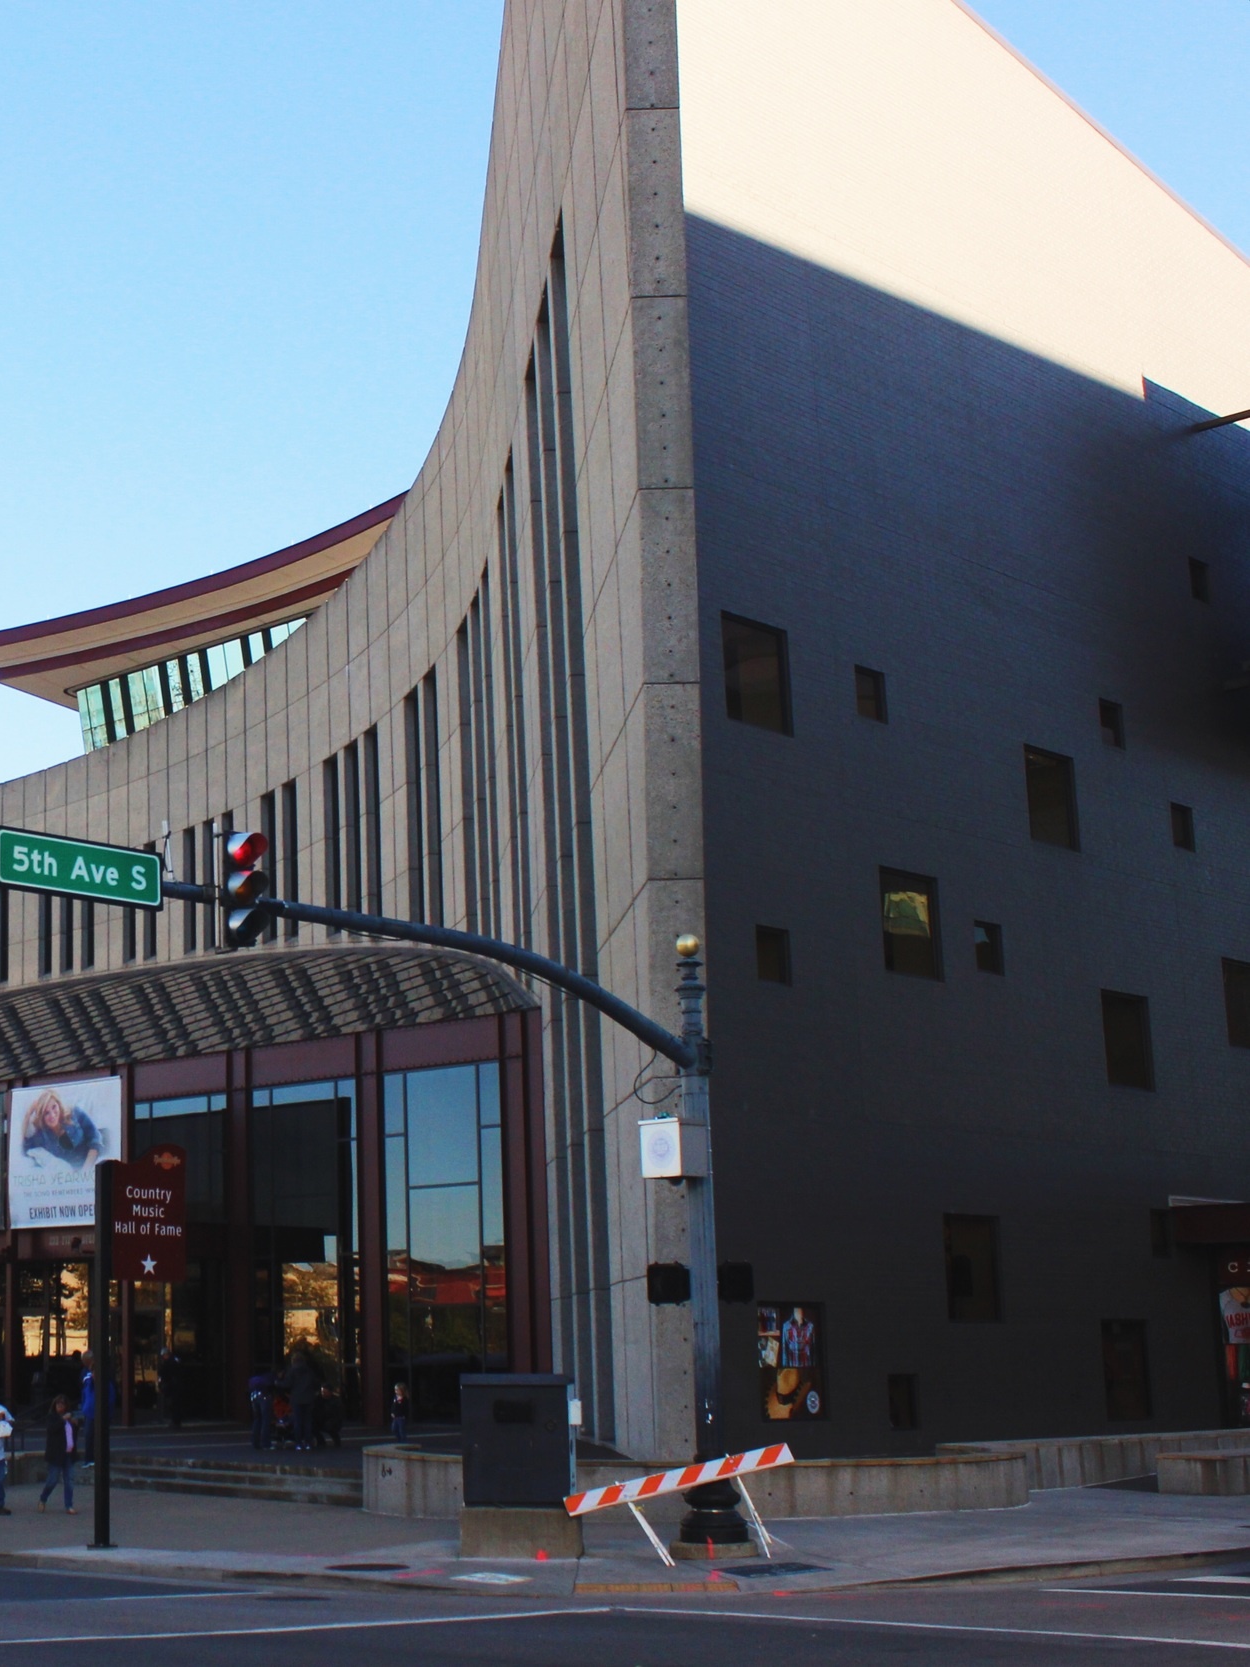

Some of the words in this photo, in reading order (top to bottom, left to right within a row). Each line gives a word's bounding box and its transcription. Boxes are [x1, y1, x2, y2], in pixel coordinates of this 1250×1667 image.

[12, 845, 57, 877] 5th
[70, 856, 119, 886] Ave
[131, 865, 147, 890] S
[13, 1173, 46, 1187] TRISHA
[126, 1185, 172, 1204] Country
[29, 1206, 57, 1220] EXHIBIT
[59, 1205, 76, 1218] NOW
[78, 1204, 95, 1217] OPE
[132, 1204, 165, 1218] Music
[114, 1222, 136, 1234] Hall
[140, 1222, 150, 1235] of
[154, 1223, 182, 1237] Fame
[1226, 1312, 1250, 1328] ASH
